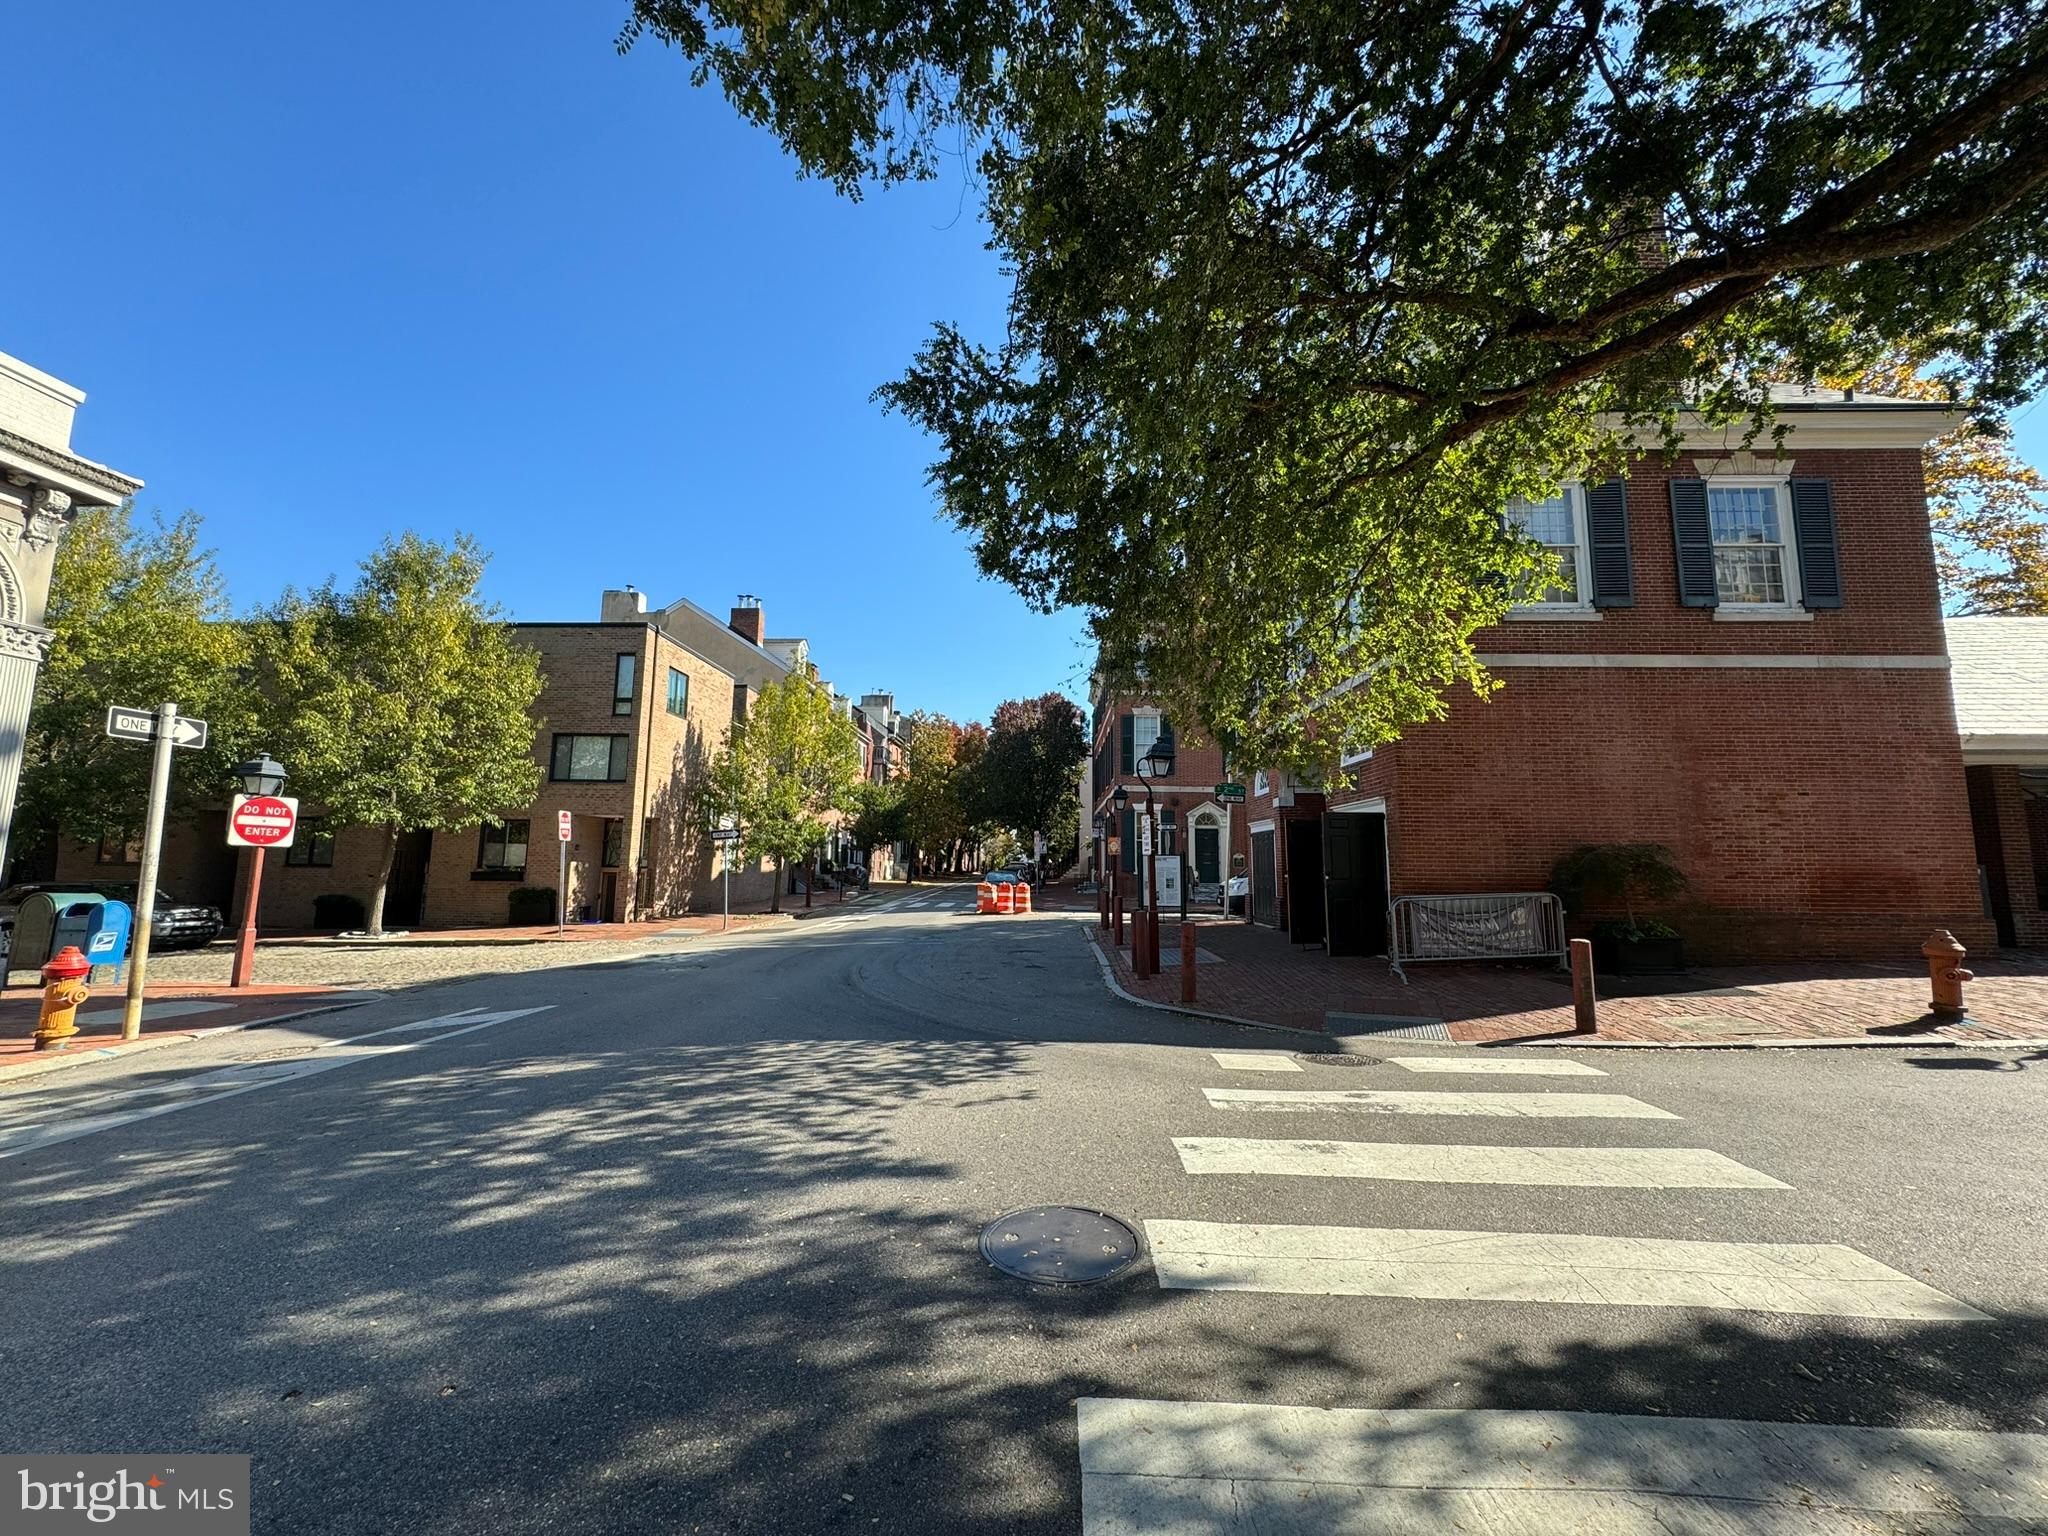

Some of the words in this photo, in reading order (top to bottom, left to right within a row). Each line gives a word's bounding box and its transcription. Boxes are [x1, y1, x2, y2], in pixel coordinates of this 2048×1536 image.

[121, 717, 148, 731] ONE
[243, 805, 260, 814] DO
[265, 806, 288, 816] NOT
[244, 826, 281, 837] ENTER
